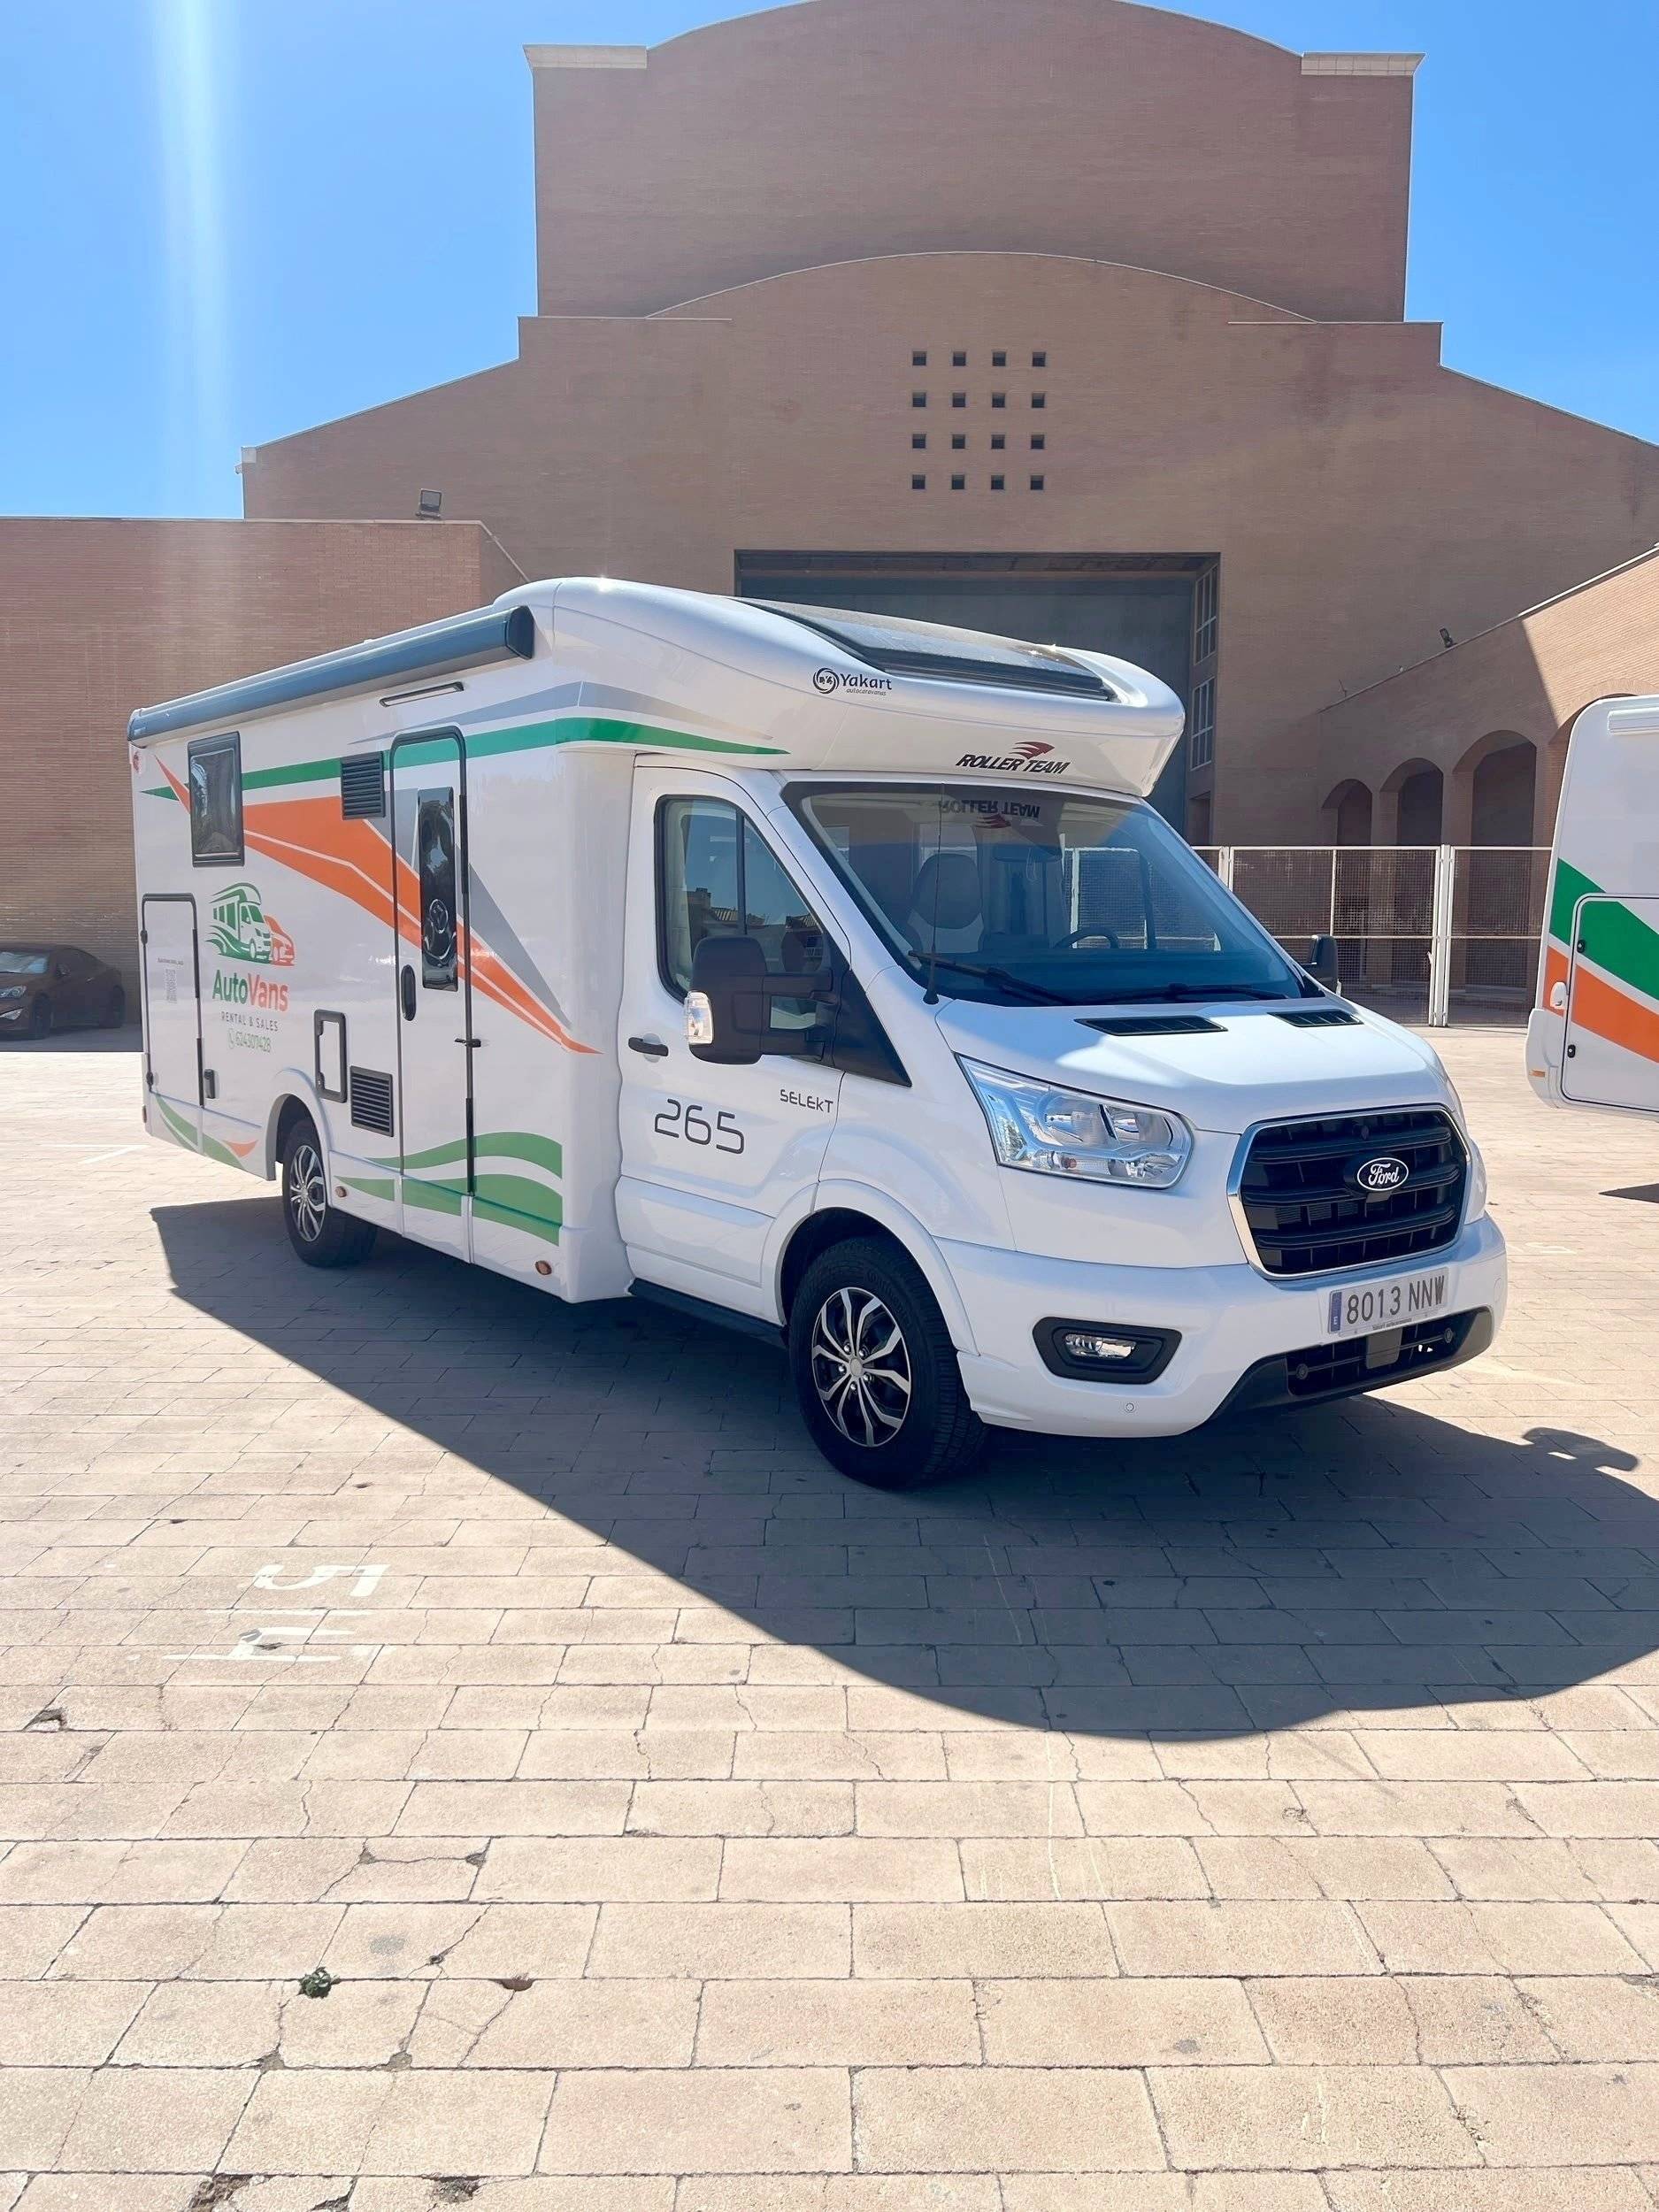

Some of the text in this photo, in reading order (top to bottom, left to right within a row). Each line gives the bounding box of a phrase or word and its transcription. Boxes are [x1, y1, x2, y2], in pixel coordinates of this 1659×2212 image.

[840, 672, 893, 690] Yakart
[956, 754, 1071, 774] ROLLER TEAM
[211, 969, 288, 1012] AutoVans
[221, 1010, 246, 1025] RENTAL
[256, 1017, 279, 1033] SALES
[654, 1098, 744, 1155] 265
[1367, 1163, 1400, 1186] Ford
[1346, 1286, 1402, 1325] 8013
[1408, 1275, 1445, 1311] NNW
